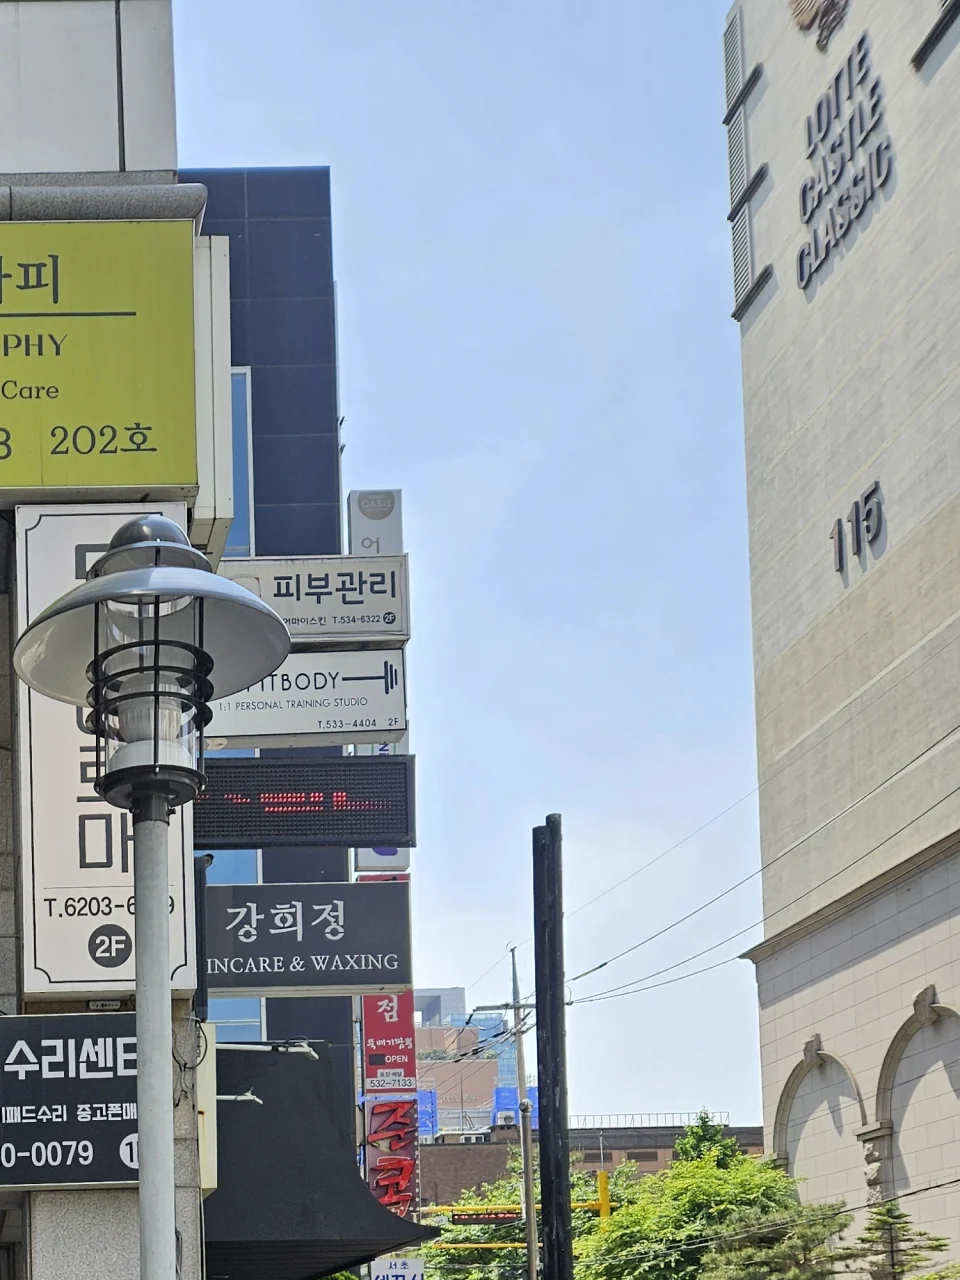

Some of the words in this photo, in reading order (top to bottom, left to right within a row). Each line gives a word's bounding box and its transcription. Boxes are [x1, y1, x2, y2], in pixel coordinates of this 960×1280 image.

[804, 29, 870, 160] LOTTE
[799, 74, 883, 225] CASTLE
[796, 137, 892, 290] CLASSIC
[1, 379, 60, 400] Care
[50, 421, 158, 456] 202호
[361, 499, 392, 509] OASIS
[829, 480, 883, 573] 115
[273, 571, 396, 605] 피부관리
[332, 614, 381, 625] T.534-6322
[246, 672, 340, 692] ITBODY
[235, 701, 283, 711] PERSONAL
[286, 699, 330, 709] TRAINING
[333, 697, 368, 707] STUDIO
[318, 718, 377, 729] T.533-4404
[388, 717, 399, 727] 2F
[43, 896, 175, 918] T.6203-6
[226, 900, 345, 943] 강희정
[95, 935, 126, 957] 2F
[207, 956, 285, 974] INCARE
[290, 956, 305, 971] &
[310, 954, 399, 971] WAXING
[385, 1055, 408, 1063] OPEN
[370, 1079, 412, 1088] 532-7133
[388, 1261, 409, 1269] 서초
